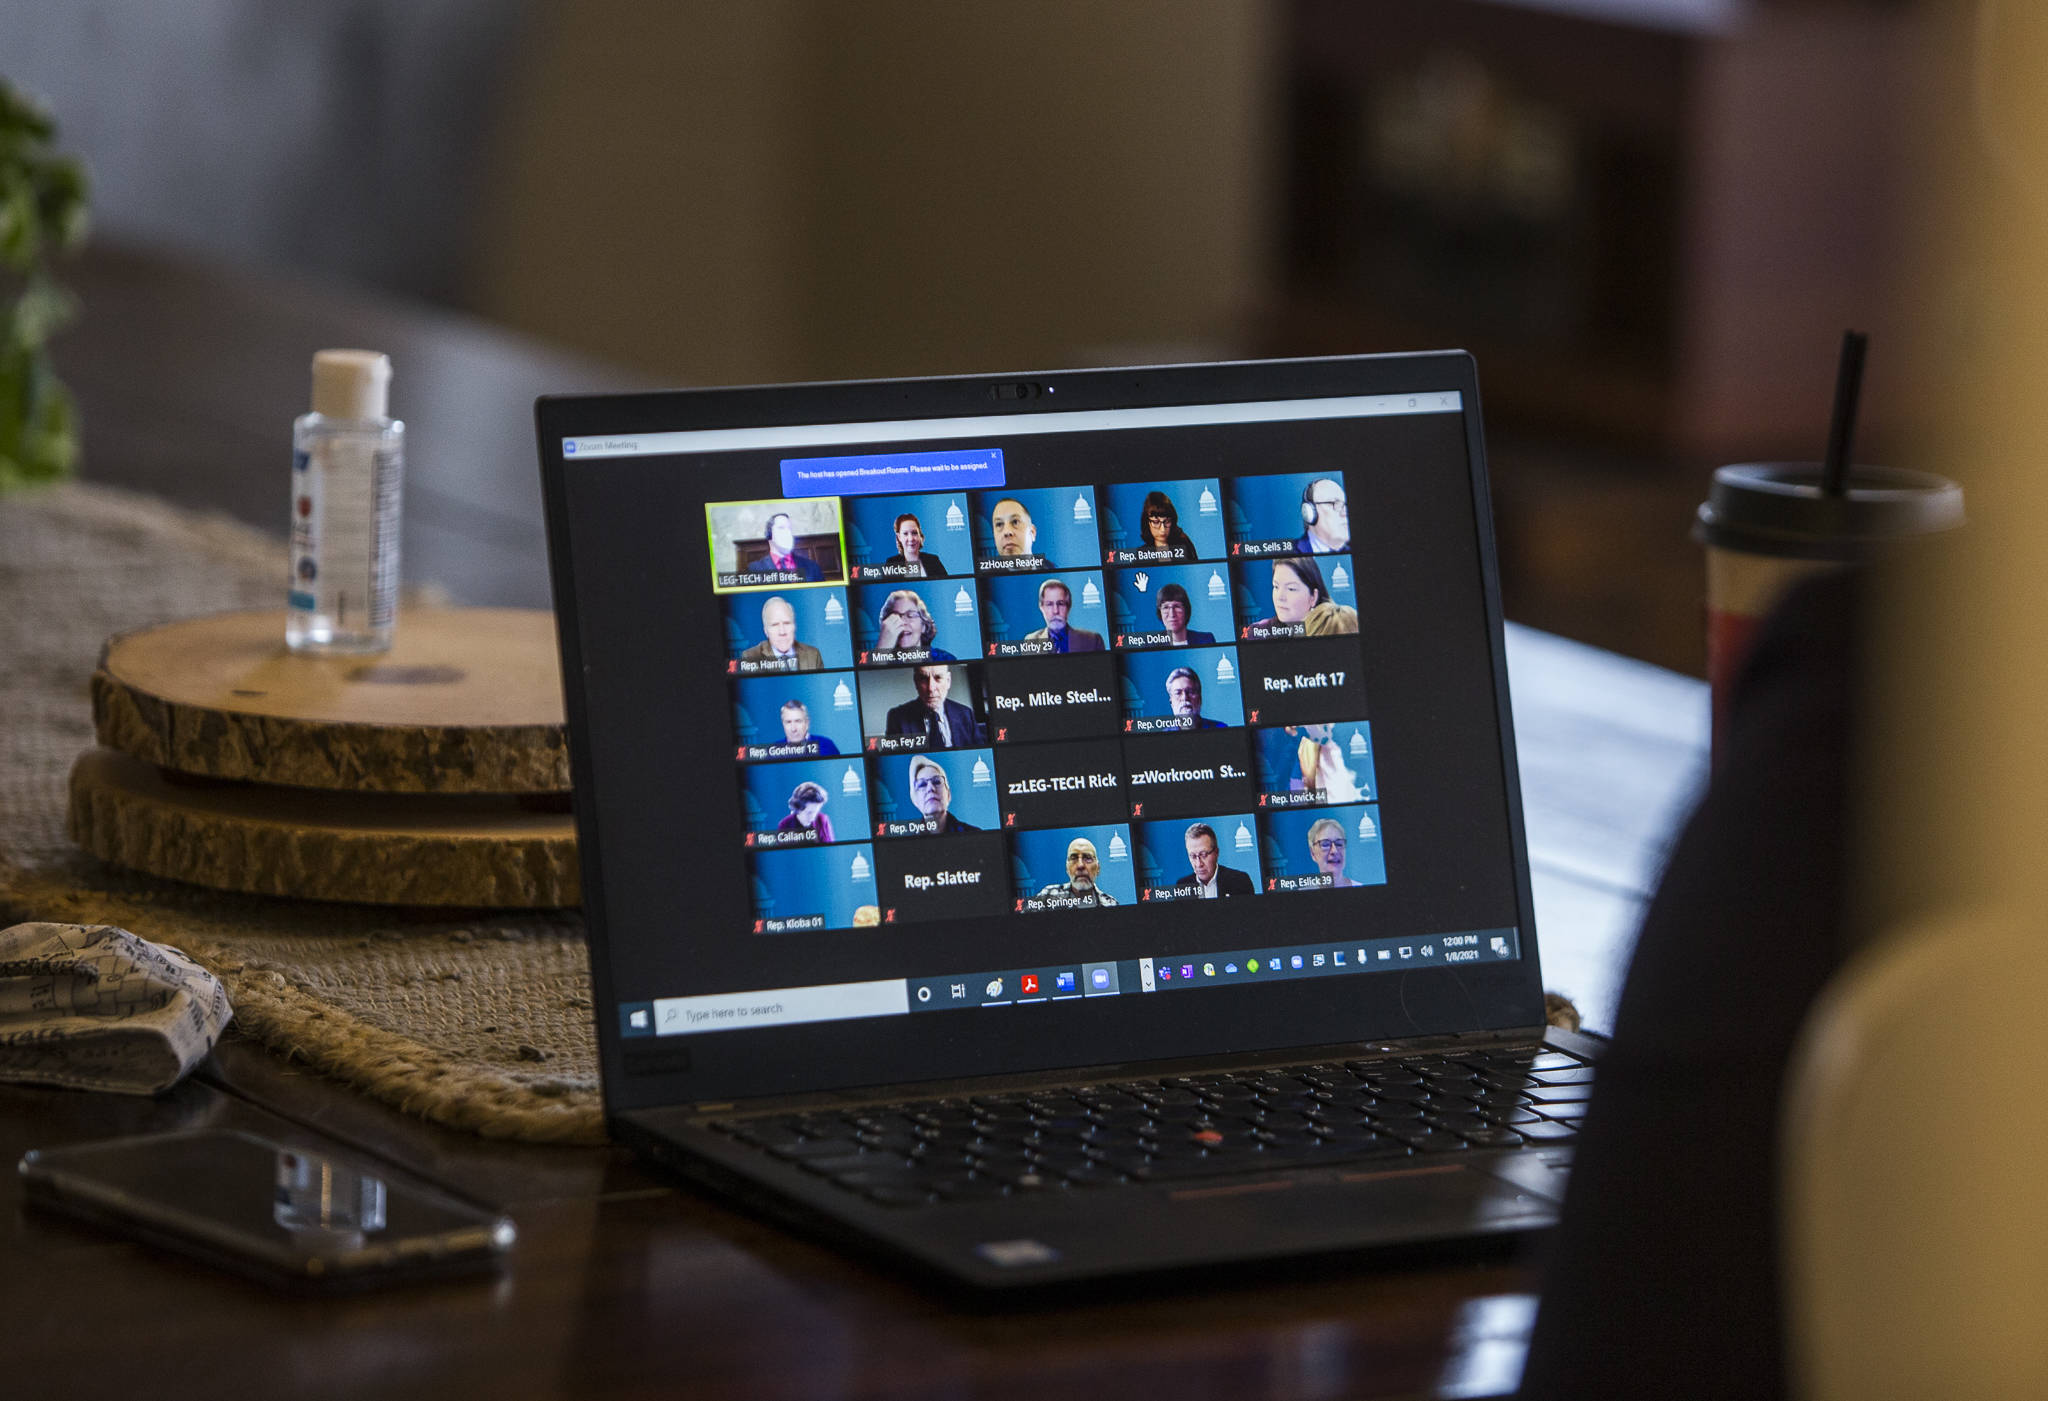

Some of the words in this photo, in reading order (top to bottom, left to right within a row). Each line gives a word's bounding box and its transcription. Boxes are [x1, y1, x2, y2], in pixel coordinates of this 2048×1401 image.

[605, 440, 638, 450] Meeting
[797, 471, 809, 479] The
[810, 470, 823, 478] host
[836, 468, 858, 478] opened
[859, 466, 886, 476] Breakout
[886, 465, 909, 474] Rooms.
[910, 464, 932, 473] Please
[932, 464, 944, 472] wait
[944, 463, 950, 471] to
[951, 463, 959, 471] be
[1244, 544, 1262, 554] Rep.
[1263, 542, 1281, 552] Sells
[1282, 541, 1293, 551] 38
[1119, 551, 1137, 562] Rep.
[1138, 549, 1173, 560] Bateman
[1175, 548, 1185, 559] 22
[980, 559, 1014, 570] zzHouse
[1015, 556, 1044, 568] Reader
[863, 567, 881, 578] Rep.
[882, 565, 907, 576] Wicks
[908, 564, 919, 574] 38
[719, 574, 761, 585] LEG-TECH
[762, 572, 777, 583] Jeff
[1253, 628, 1271, 638] Rep.
[1272, 626, 1293, 636] Berry
[1294, 624, 1304, 634] 36
[1128, 635, 1146, 646] Rep.
[1147, 633, 1171, 644] Dolan
[1001, 644, 1019, 654] Rep.
[1020, 642, 1041, 654] Kirby
[1042, 641, 1053, 651] 29
[872, 652, 896, 662] Mme.
[897, 649, 930, 662] Speaker
[740, 660, 759, 671] Rep.
[760, 658, 786, 669] Harris
[787, 657, 798, 668] 17
[1263, 676, 1293, 693] Rep.
[1294, 673, 1328, 689] Kraft
[1329, 671, 1346, 686] 17
[995, 695, 1024, 711] Rep.
[1028, 691, 1062, 707] Mike
[1066, 688, 1112, 704] Steel...
[1137, 720, 1154, 730] Rep.
[1155, 718, 1181, 728] Orcutt
[1182, 717, 1193, 727] 20
[881, 738, 899, 749] Rep.
[900, 737, 914, 748] Fey
[915, 735, 927, 746] 27
[749, 748, 767, 759] Rep.
[768, 745, 806, 756] Goehner
[807, 743, 817, 754] 12
[1131, 767, 1214, 785] zzWorkroom
[1220, 764, 1246, 779] St...
[1008, 776, 1086, 794] zzLEG-TECH
[1089, 773, 1118, 789] Rick
[1271, 795, 1289, 805] Rep.
[1290, 792, 1315, 803] Lovick
[1315, 791, 1326, 801] 44
[889, 823, 908, 834] Rep.
[909, 822, 925, 833] Dye
[926, 820, 938, 831] 09
[758, 833, 776, 845] Rep.
[777, 831, 804, 842] Callan
[805, 830, 817, 840] 05
[904, 874, 934, 890] Rep.
[936, 870, 982, 886] Slatter
[1280, 878, 1298, 889] Rep.
[1299, 876, 1321, 887] Eslick
[1321, 875, 1332, 885] 39
[1155, 889, 1173, 900] Rep.
[1174, 887, 1191, 897] Hoff
[1192, 886, 1203, 896] 18
[1028, 899, 1046, 911] Rep.
[1047, 896, 1081, 908] Springer
[1082, 895, 1093, 905] 45
[766, 920, 785, 931] Rep.
[812, 916, 823, 927] 01
[1443, 936, 1463, 947] 12:00
[1464, 935, 1478, 945] PM
[1445, 950, 1479, 962] 1/8/2021
[686, 1009, 709, 1023] Type
[712, 1008, 734, 1019] here
[737, 1007, 748, 1017] to
[751, 1003, 784, 1016] search
